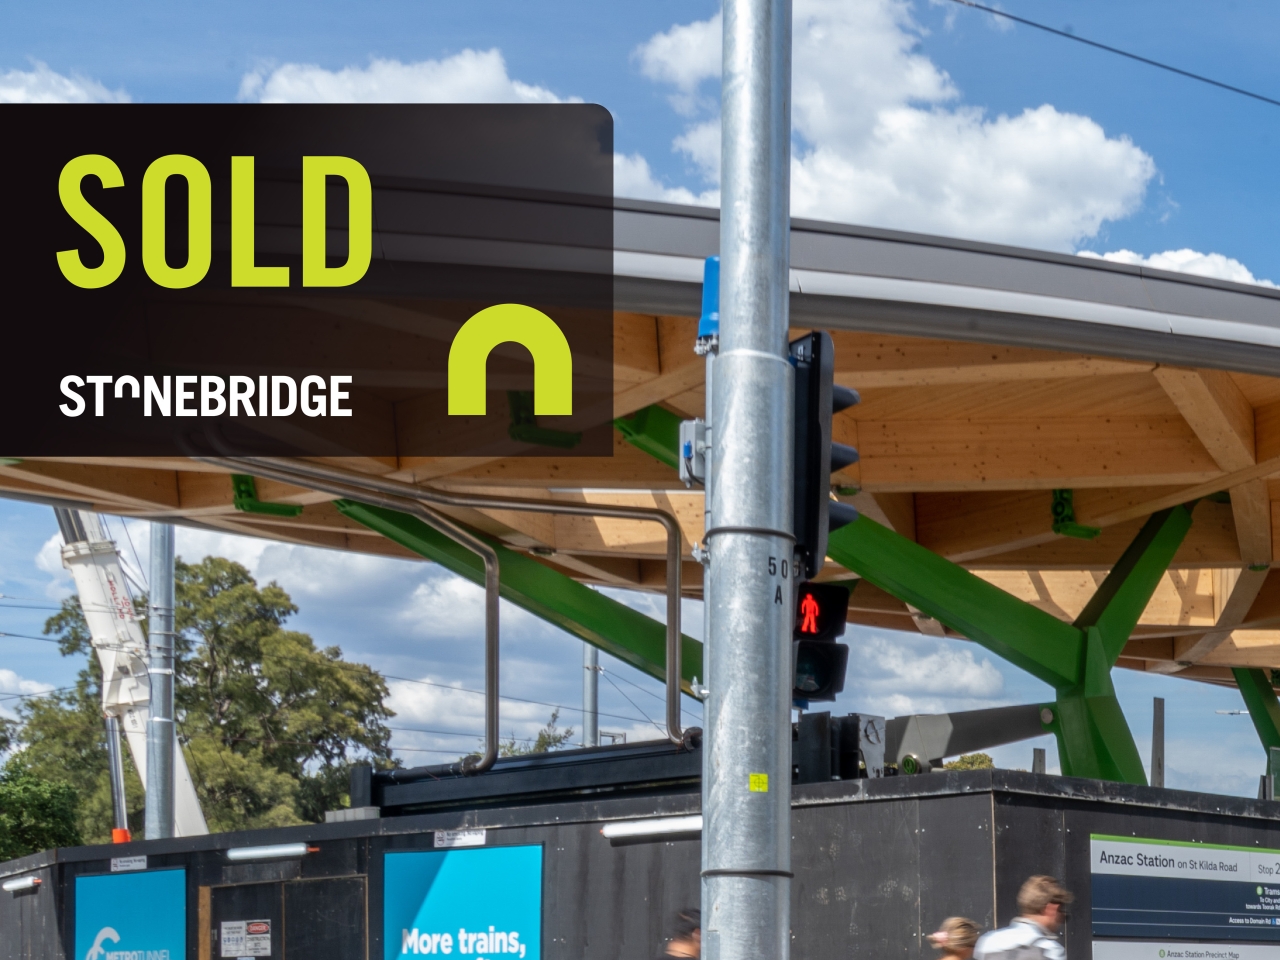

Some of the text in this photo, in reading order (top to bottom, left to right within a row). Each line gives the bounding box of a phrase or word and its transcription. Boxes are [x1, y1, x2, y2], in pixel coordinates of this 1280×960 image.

[774, 585, 783, 605] A
[1100, 851, 1238, 872] Anzac Station on St Kilda Road
[1258, 865, 1274, 876] Stop
[1264, 887, 1280, 896] Trams
[403, 928, 526, 958] More trains,
[1167, 950, 1184, 958] Anzac
[1206, 951, 1228, 959] Precinct
[1229, 952, 1240, 960] Map
